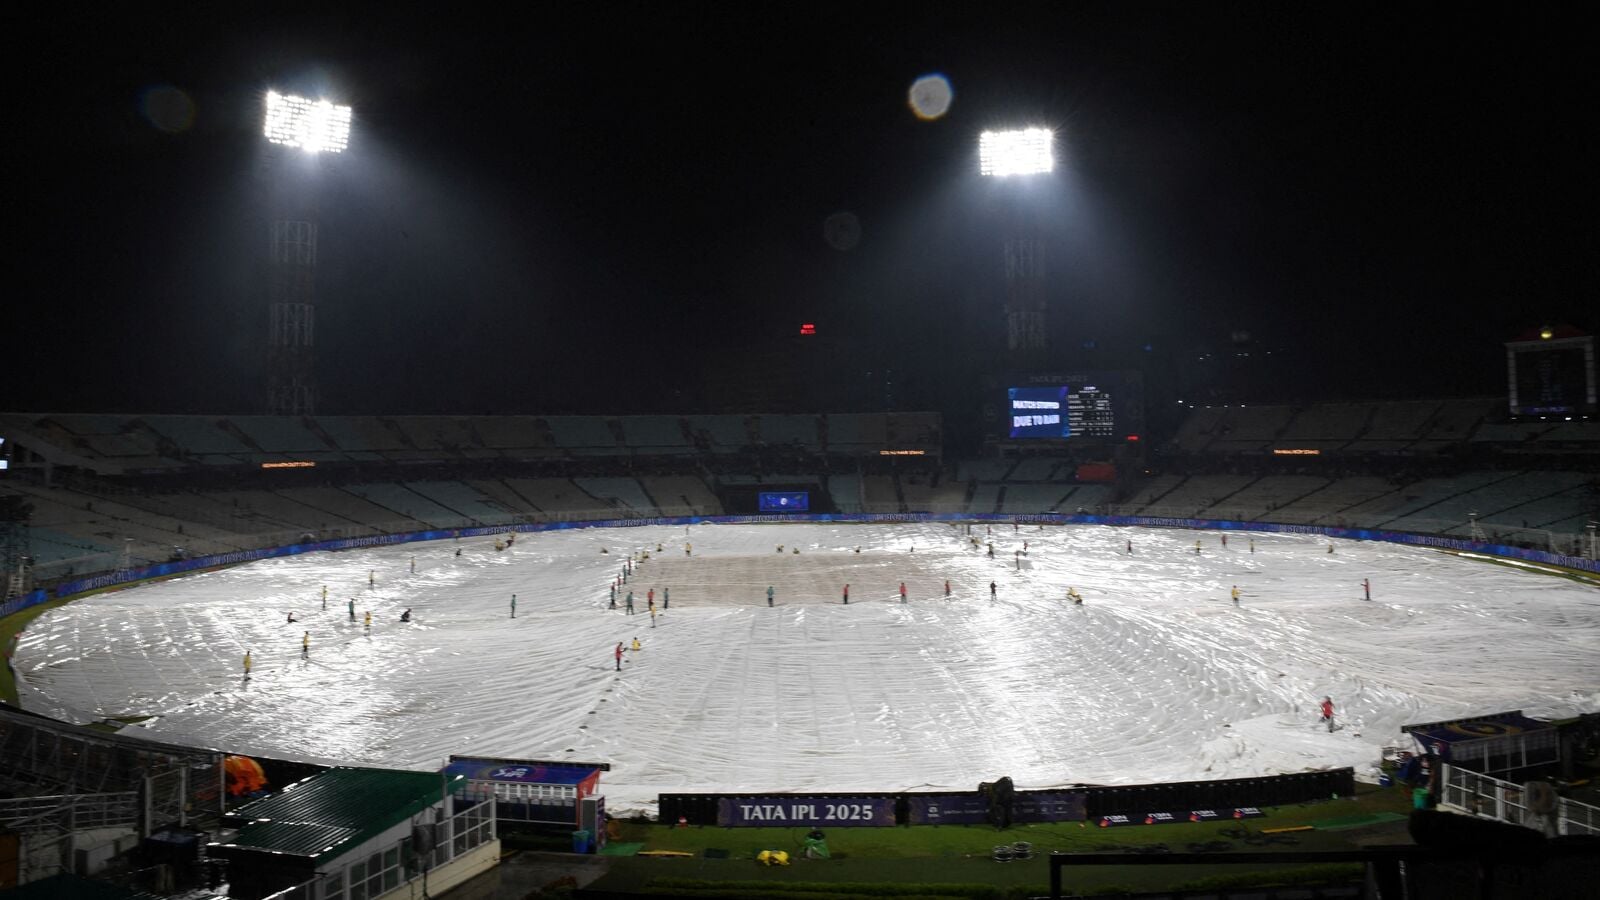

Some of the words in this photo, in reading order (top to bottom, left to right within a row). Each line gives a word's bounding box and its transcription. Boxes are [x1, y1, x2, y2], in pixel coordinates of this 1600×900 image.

[1013, 415, 1032, 428] DUE
[1032, 414, 1042, 426] TO
[1043, 413, 1060, 425] RAIN
[740, 804, 787, 820] TATA
[791, 804, 820, 820] IPL
[824, 803, 874, 820] 2025
